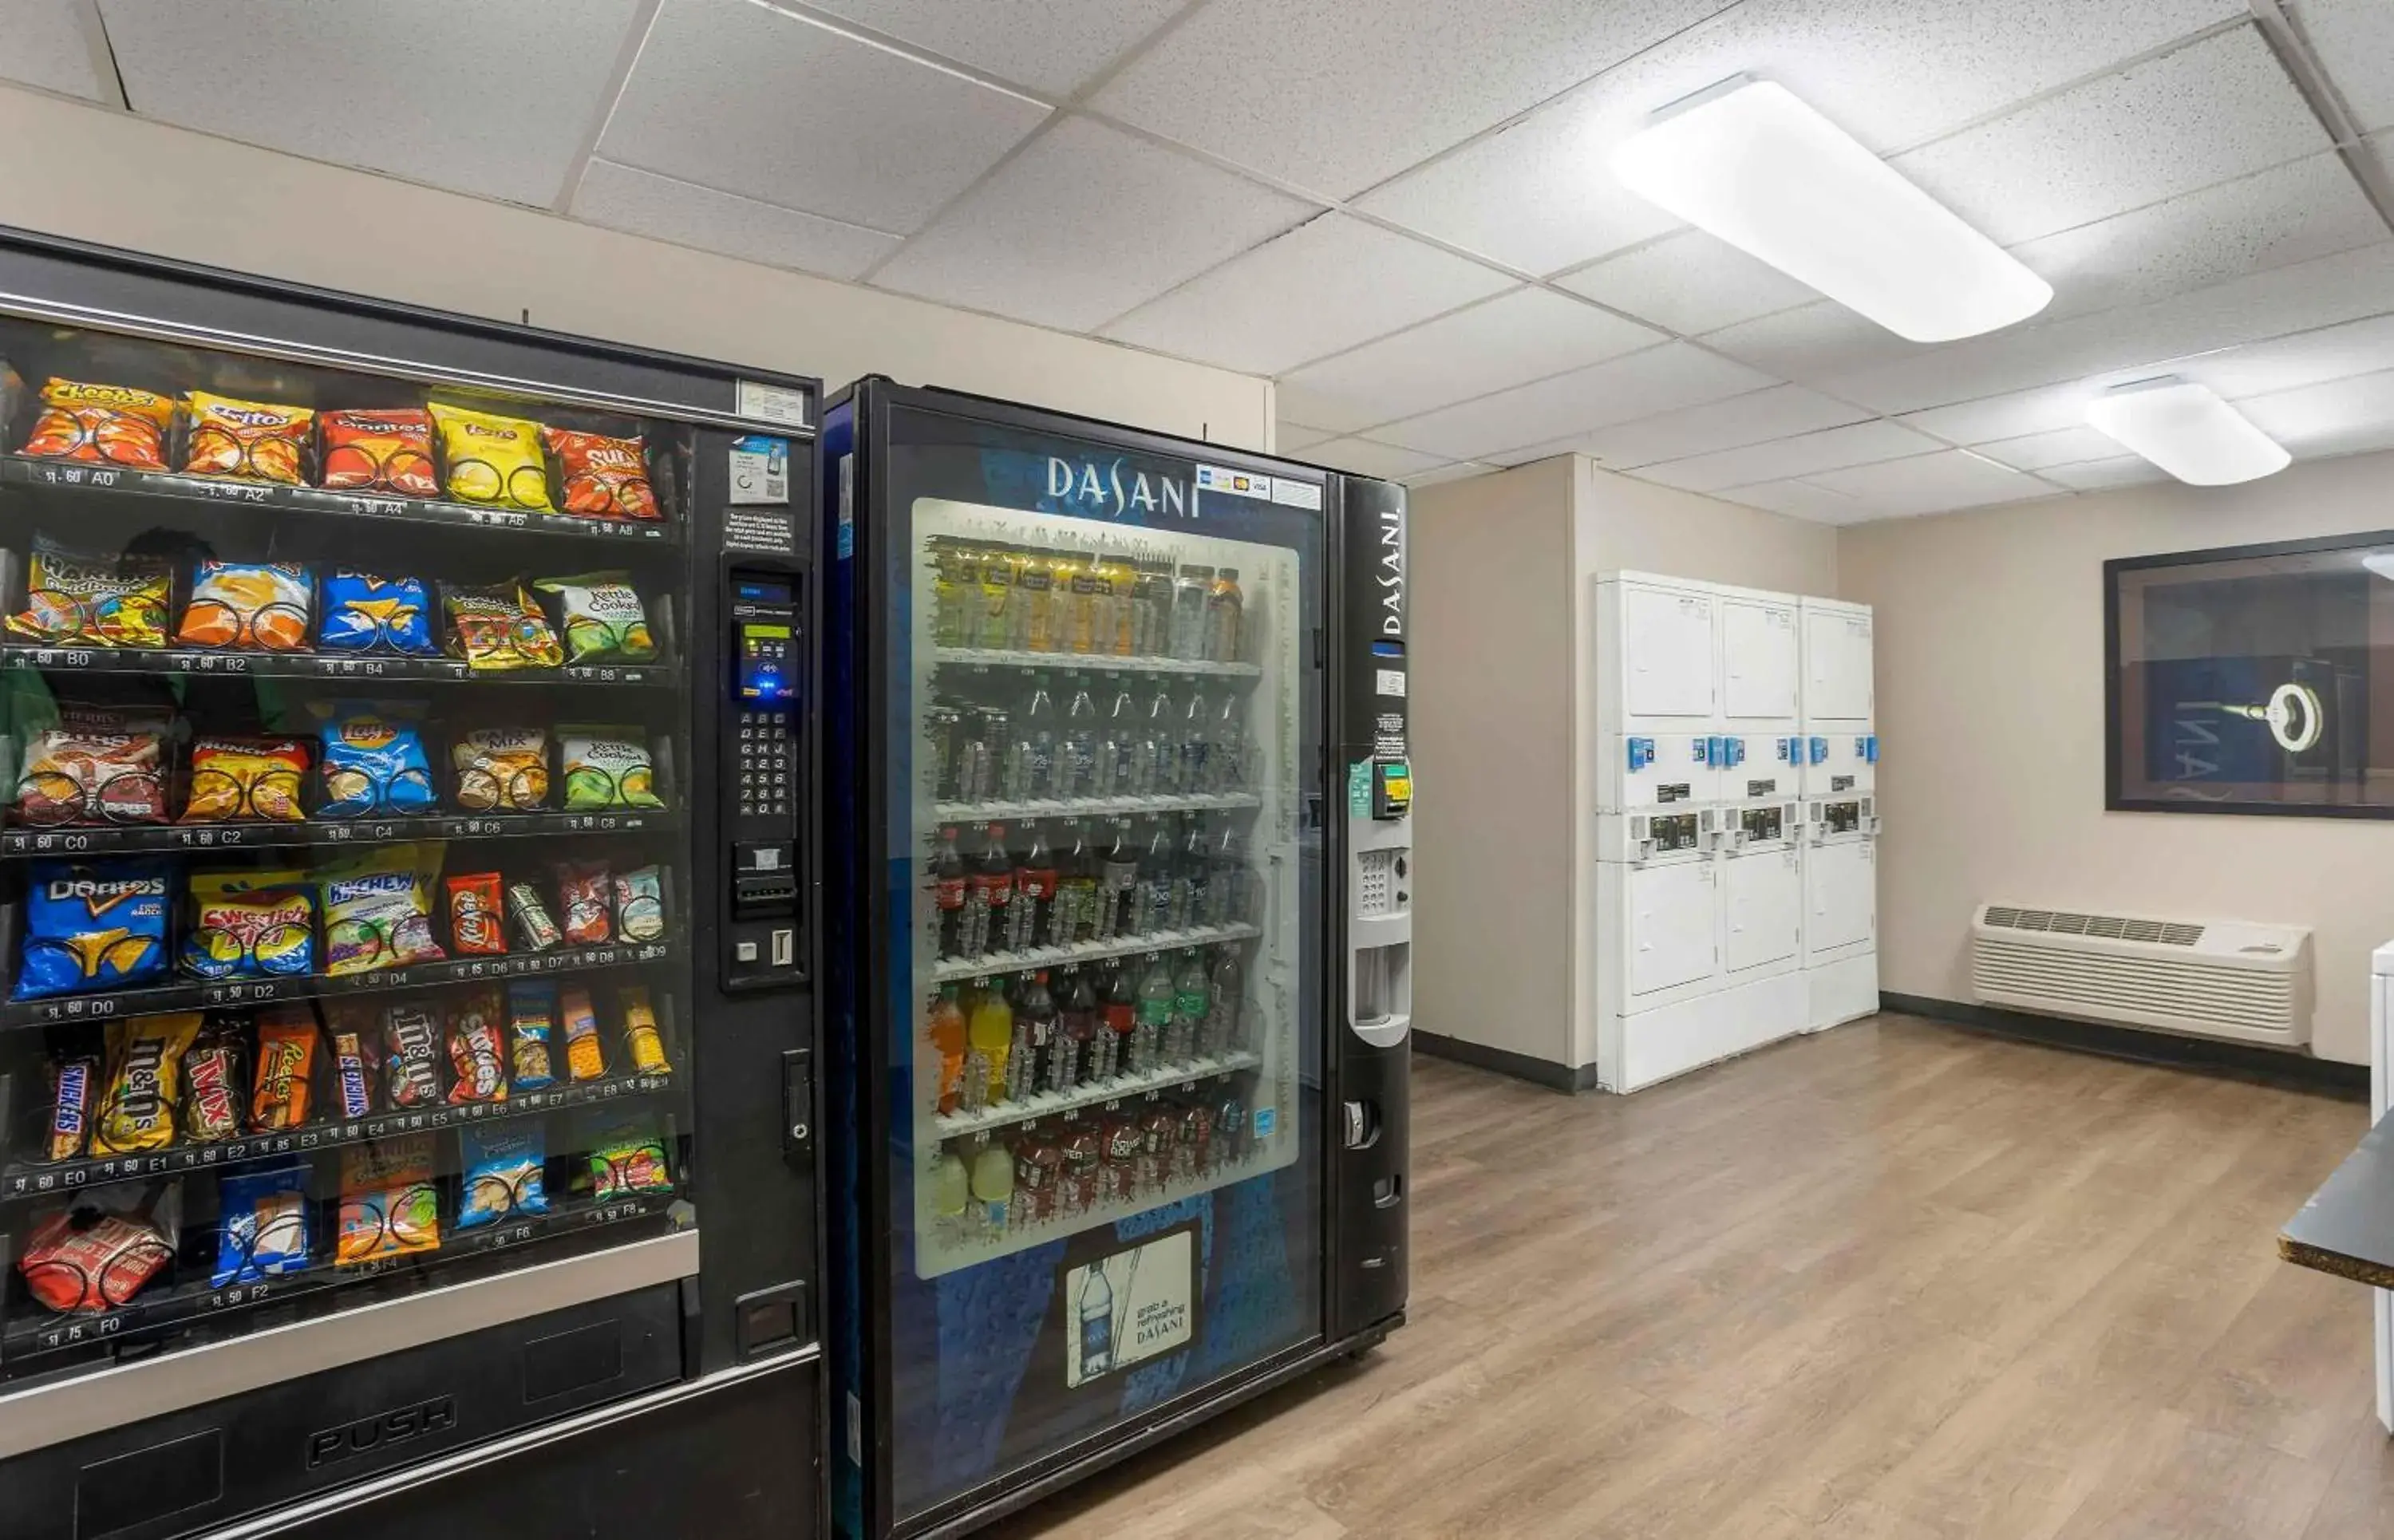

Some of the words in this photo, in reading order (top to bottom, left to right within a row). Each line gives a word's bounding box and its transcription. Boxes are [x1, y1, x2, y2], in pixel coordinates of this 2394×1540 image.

[53, 384, 155, 405] Cheetos
[1048, 456, 1199, 519] DASANI
[245, 490, 265, 501] A2
[1376, 511, 1403, 634] DASANI
[591, 590, 633, 601] Kettle
[226, 658, 245, 671] B2
[365, 664, 383, 674] B4
[488, 736, 526, 748] MIX
[221, 831, 241, 843] C2
[376, 827, 392, 837] C4
[390, 973, 407, 985] D4
[255, 985, 275, 997] D2
[189, 1051, 231, 1128] TWIX
[342, 1057, 367, 1115] SNICKERS
[57, 1067, 85, 1131] SNICKERS
[492, 1104, 508, 1115] E6
[432, 1116, 448, 1126] E5
[369, 1126, 384, 1136] E4
[301, 1135, 318, 1146] E3
[227, 1146, 245, 1158] E2
[150, 1158, 167, 1171] E1
[624, 1203, 635, 1215] F8
[252, 1285, 269, 1298] F2
[1137, 1304, 1185, 1329] refreshing
[312, 1400, 453, 1466] PUSH
